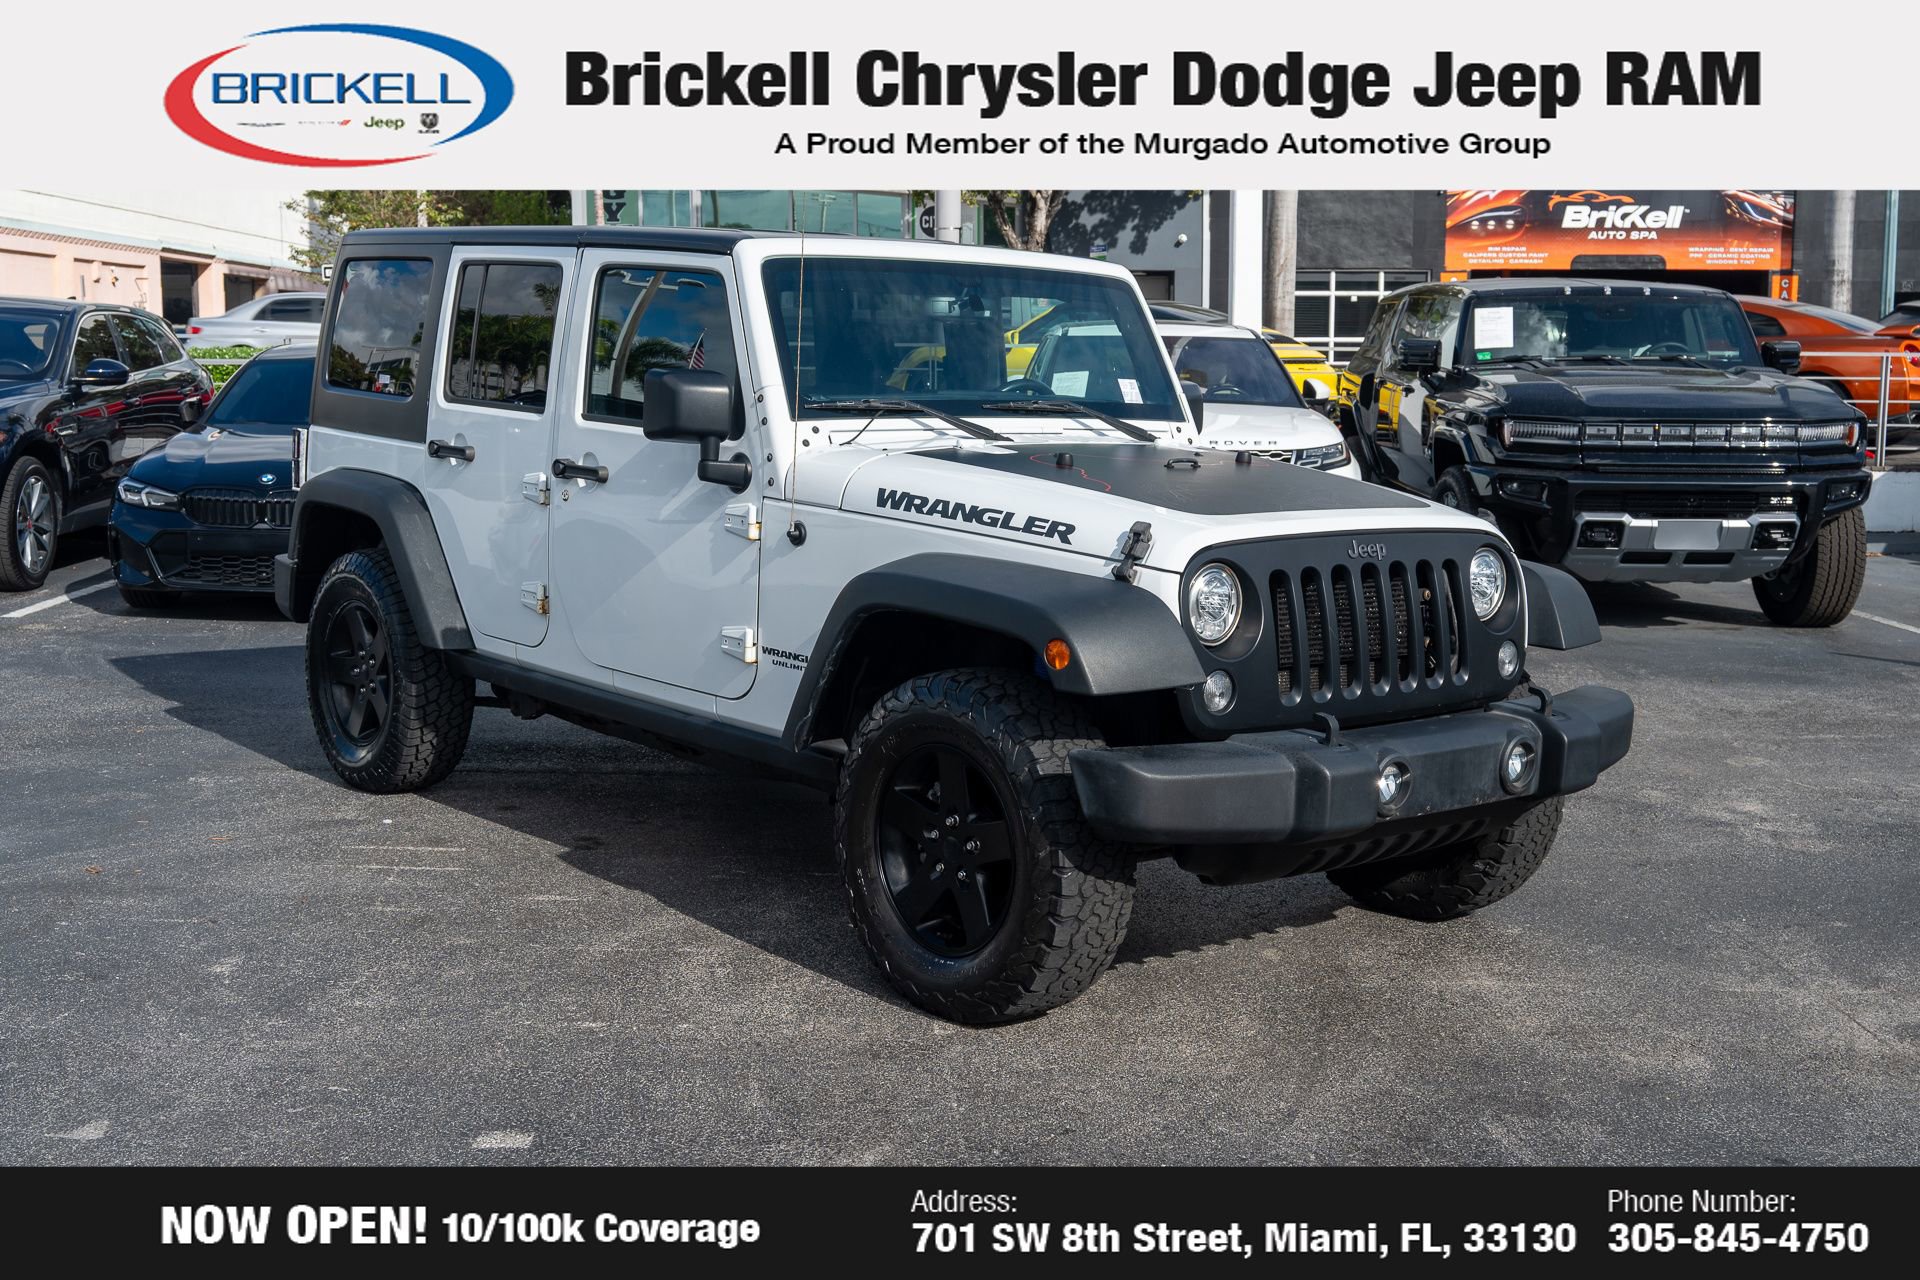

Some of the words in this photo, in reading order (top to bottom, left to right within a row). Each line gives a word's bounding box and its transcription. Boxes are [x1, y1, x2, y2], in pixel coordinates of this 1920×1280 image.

[922, 216, 935, 228] CI
[1587, 231, 1627, 240] AUTO
[1630, 231, 1658, 240] SPA
[876, 487, 1076, 546] WRANGLER
[1348, 539, 1386, 561] Jeep
[772, 659, 808, 672] UNLIMI
